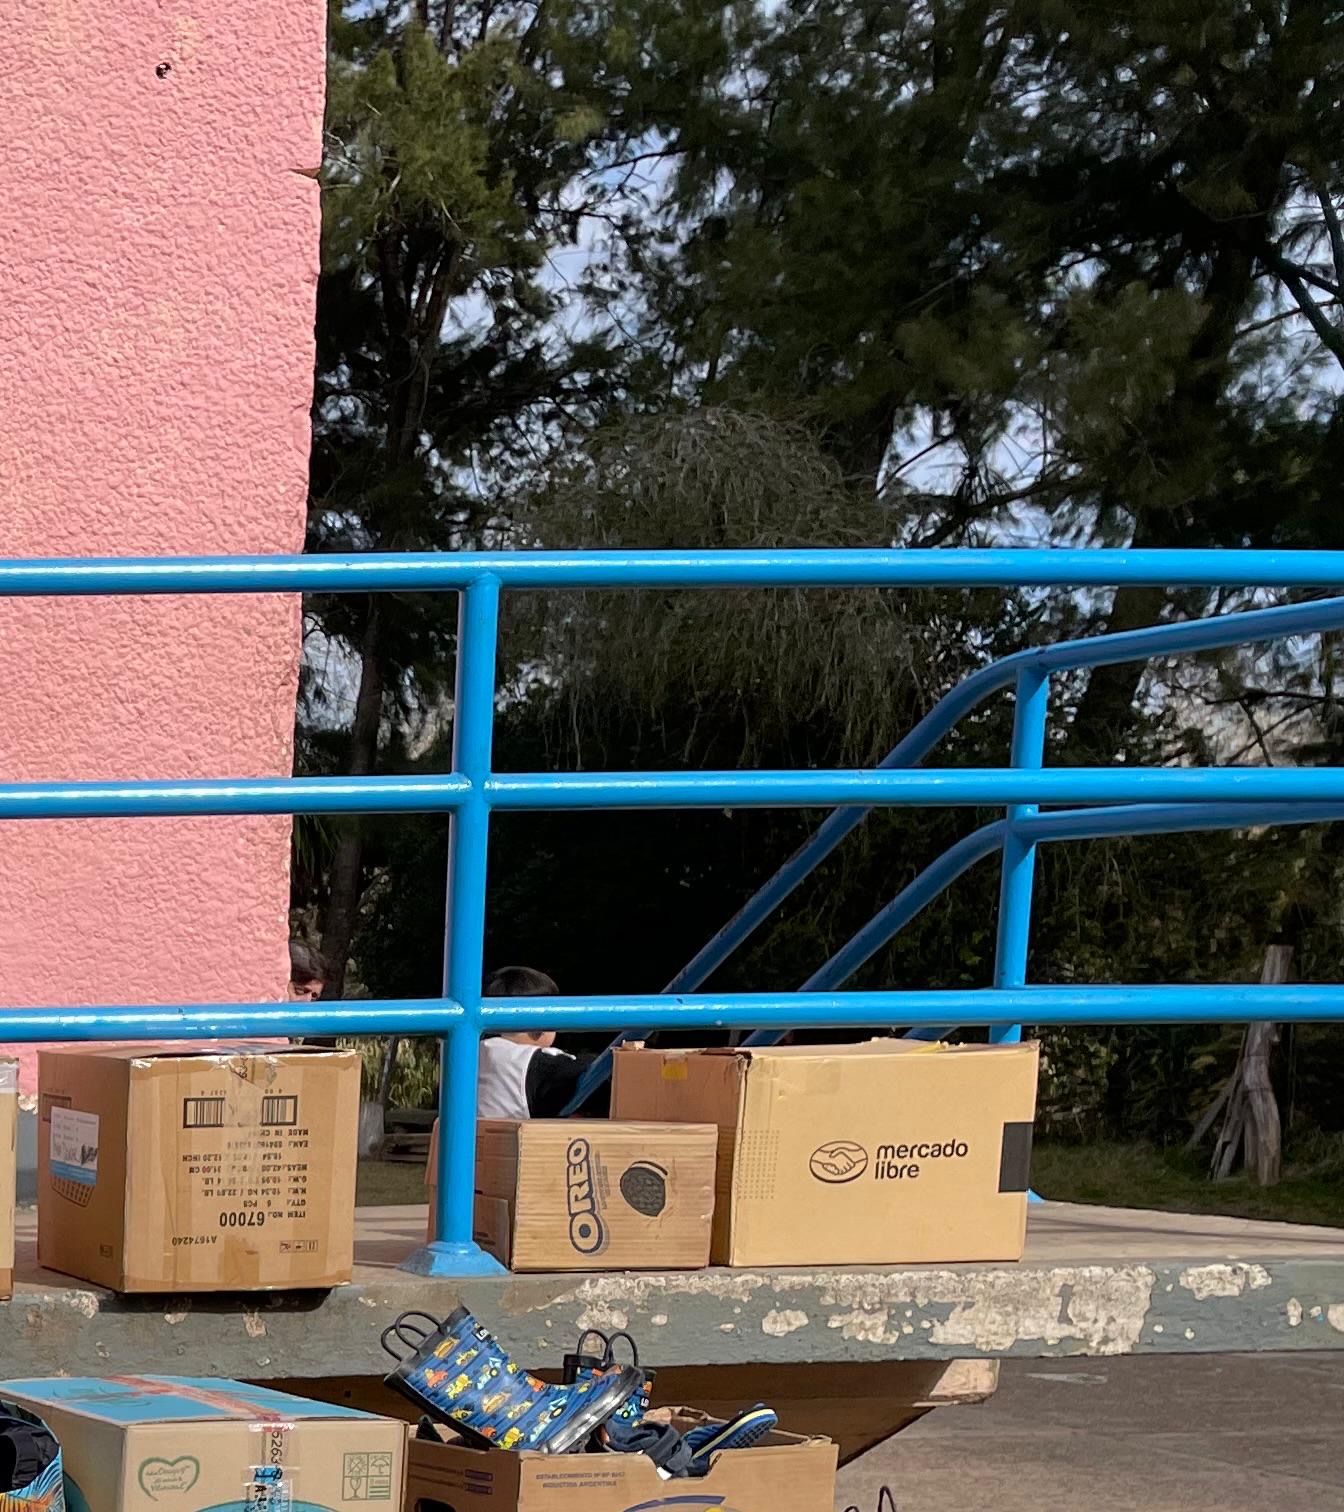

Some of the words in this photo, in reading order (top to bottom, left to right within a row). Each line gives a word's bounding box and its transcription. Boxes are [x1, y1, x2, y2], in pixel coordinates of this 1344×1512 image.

[877, 1138, 968, 1159] mercado
[875, 1161, 920, 1180] libre
[566, 1138, 605, 1254] OREO
[219, 1212, 265, 1227] 67000
